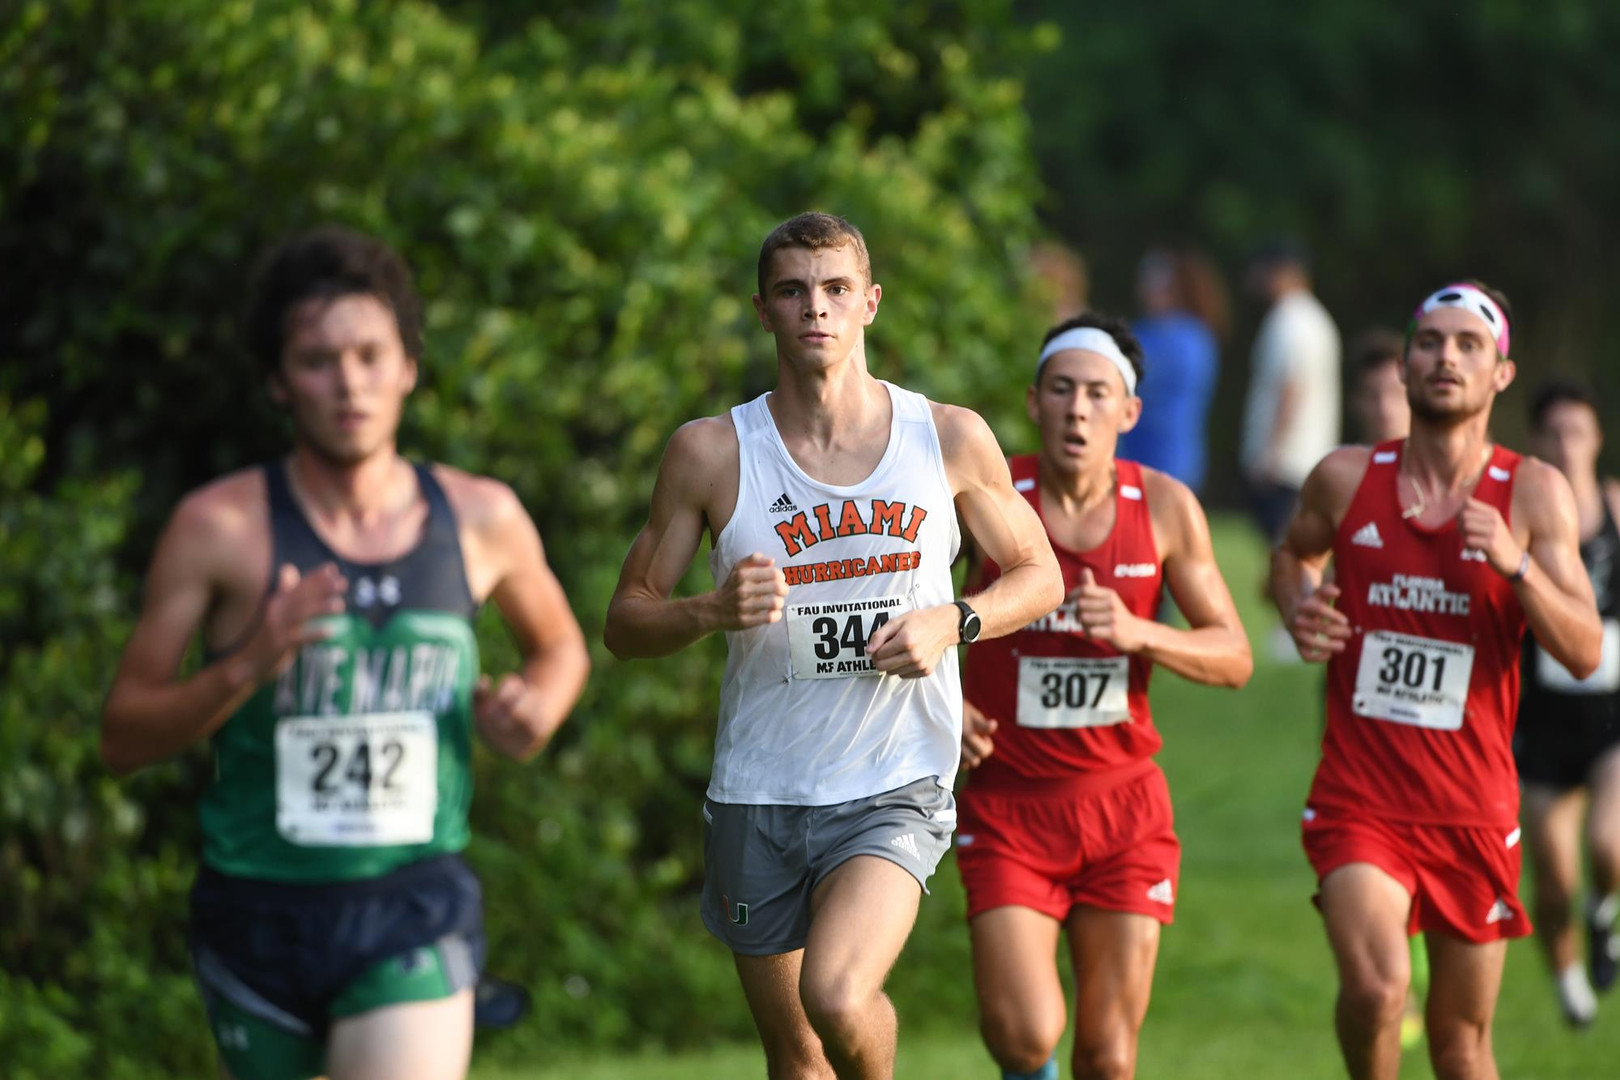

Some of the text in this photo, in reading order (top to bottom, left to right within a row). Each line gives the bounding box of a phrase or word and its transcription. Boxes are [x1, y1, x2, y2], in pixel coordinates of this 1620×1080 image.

[769, 505, 798, 514] adidas
[774, 499, 928, 557] MIAMI
[783, 551, 921, 586] HURRICANES
[797, 598, 902, 617] FAU INVITATIONAL
[1367, 582, 1470, 616] ATLANTIC
[816, 662, 834, 674] MF
[1379, 647, 1445, 692] 301
[1041, 672, 1111, 709] 307
[309, 741, 405, 792] 242
